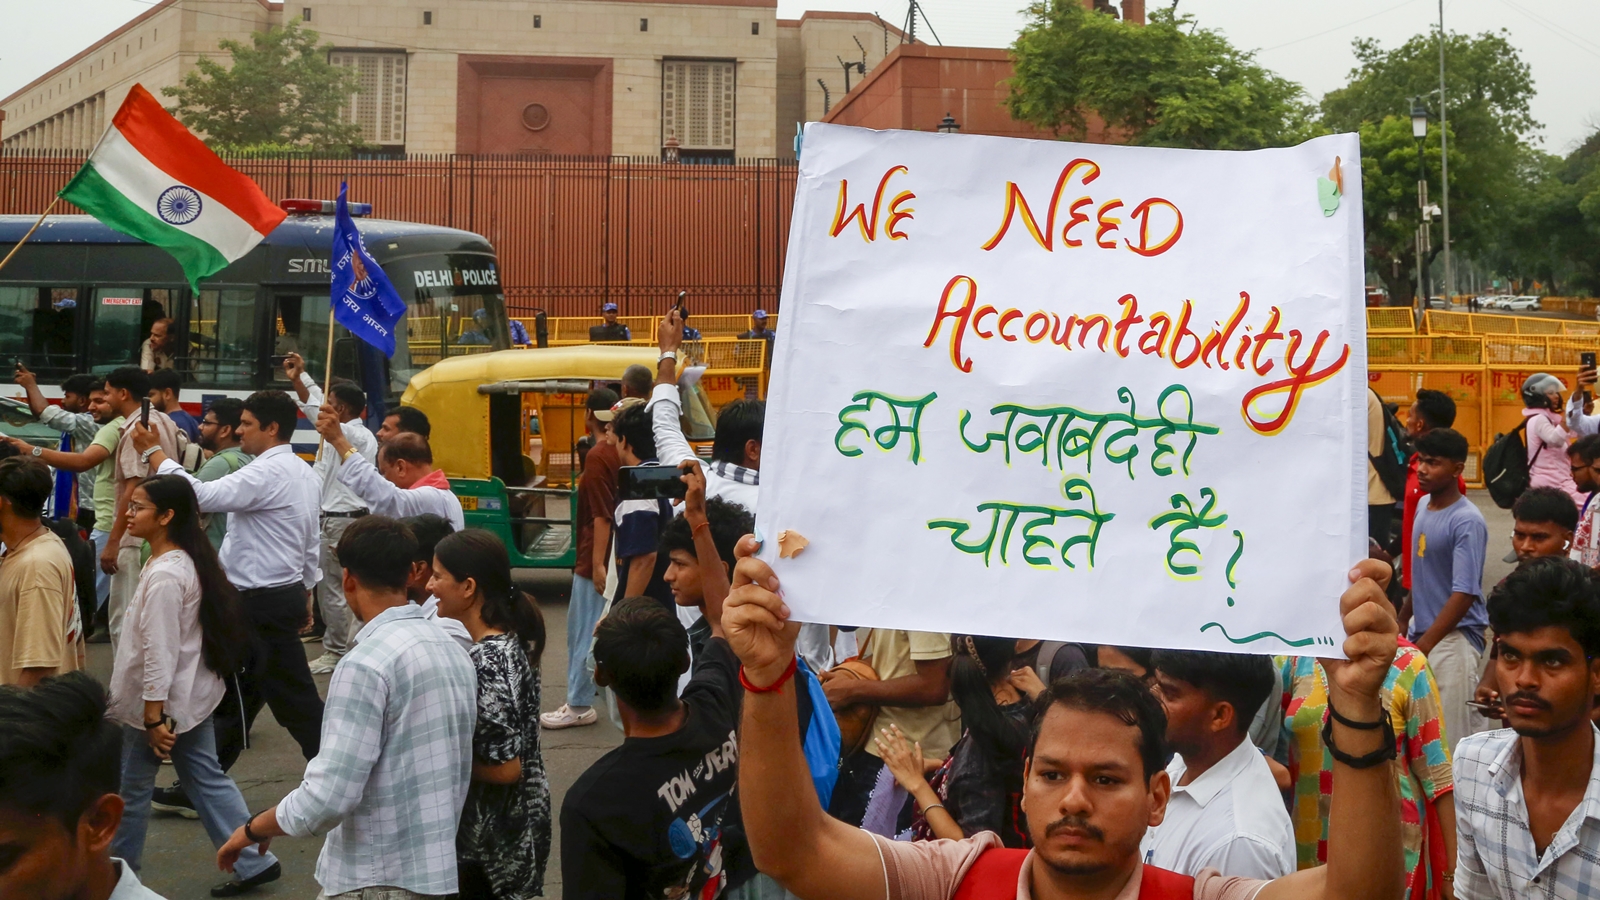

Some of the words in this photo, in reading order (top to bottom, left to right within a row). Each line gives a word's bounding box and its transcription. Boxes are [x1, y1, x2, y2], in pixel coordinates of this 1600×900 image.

[830, 165, 917, 243] WE
[980, 158, 1184, 257] NEED
[342, 294, 361, 314] जय
[362, 313, 388, 337] भारत
[413, 269, 454, 288] DELHI
[461, 269, 498, 286] POLICE
[923, 274, 1350, 437] Accountability
[835, 389, 938, 466] हम
[960, 383, 1222, 481] जवाबदेही
[926, 474, 1117, 570] चाहते
[657, 767, 697, 813] TOM
